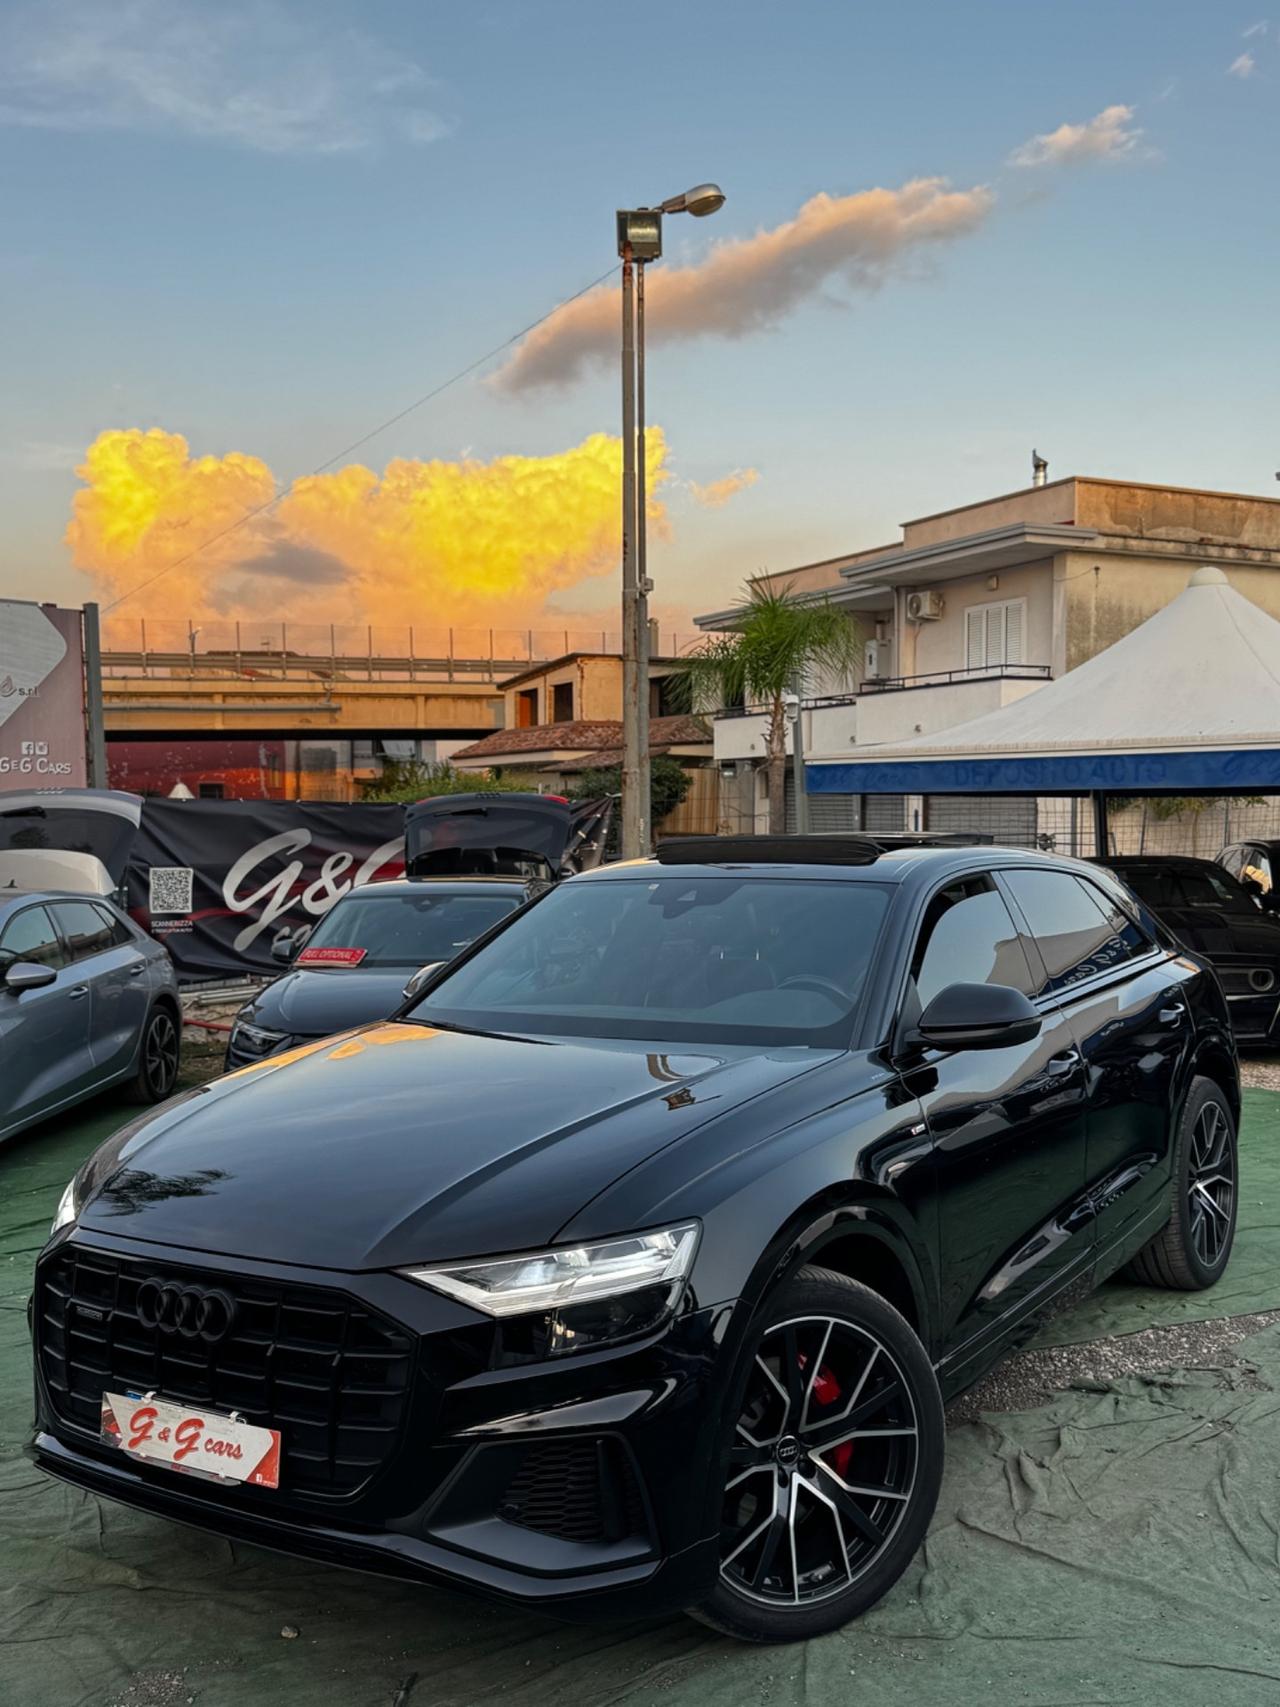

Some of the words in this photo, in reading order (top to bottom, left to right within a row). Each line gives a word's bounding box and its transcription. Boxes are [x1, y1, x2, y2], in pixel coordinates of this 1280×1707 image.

[128, 1407, 159, 1449] G
[173, 1418, 205, 1461] G
[204, 1437, 243, 1460] cars
